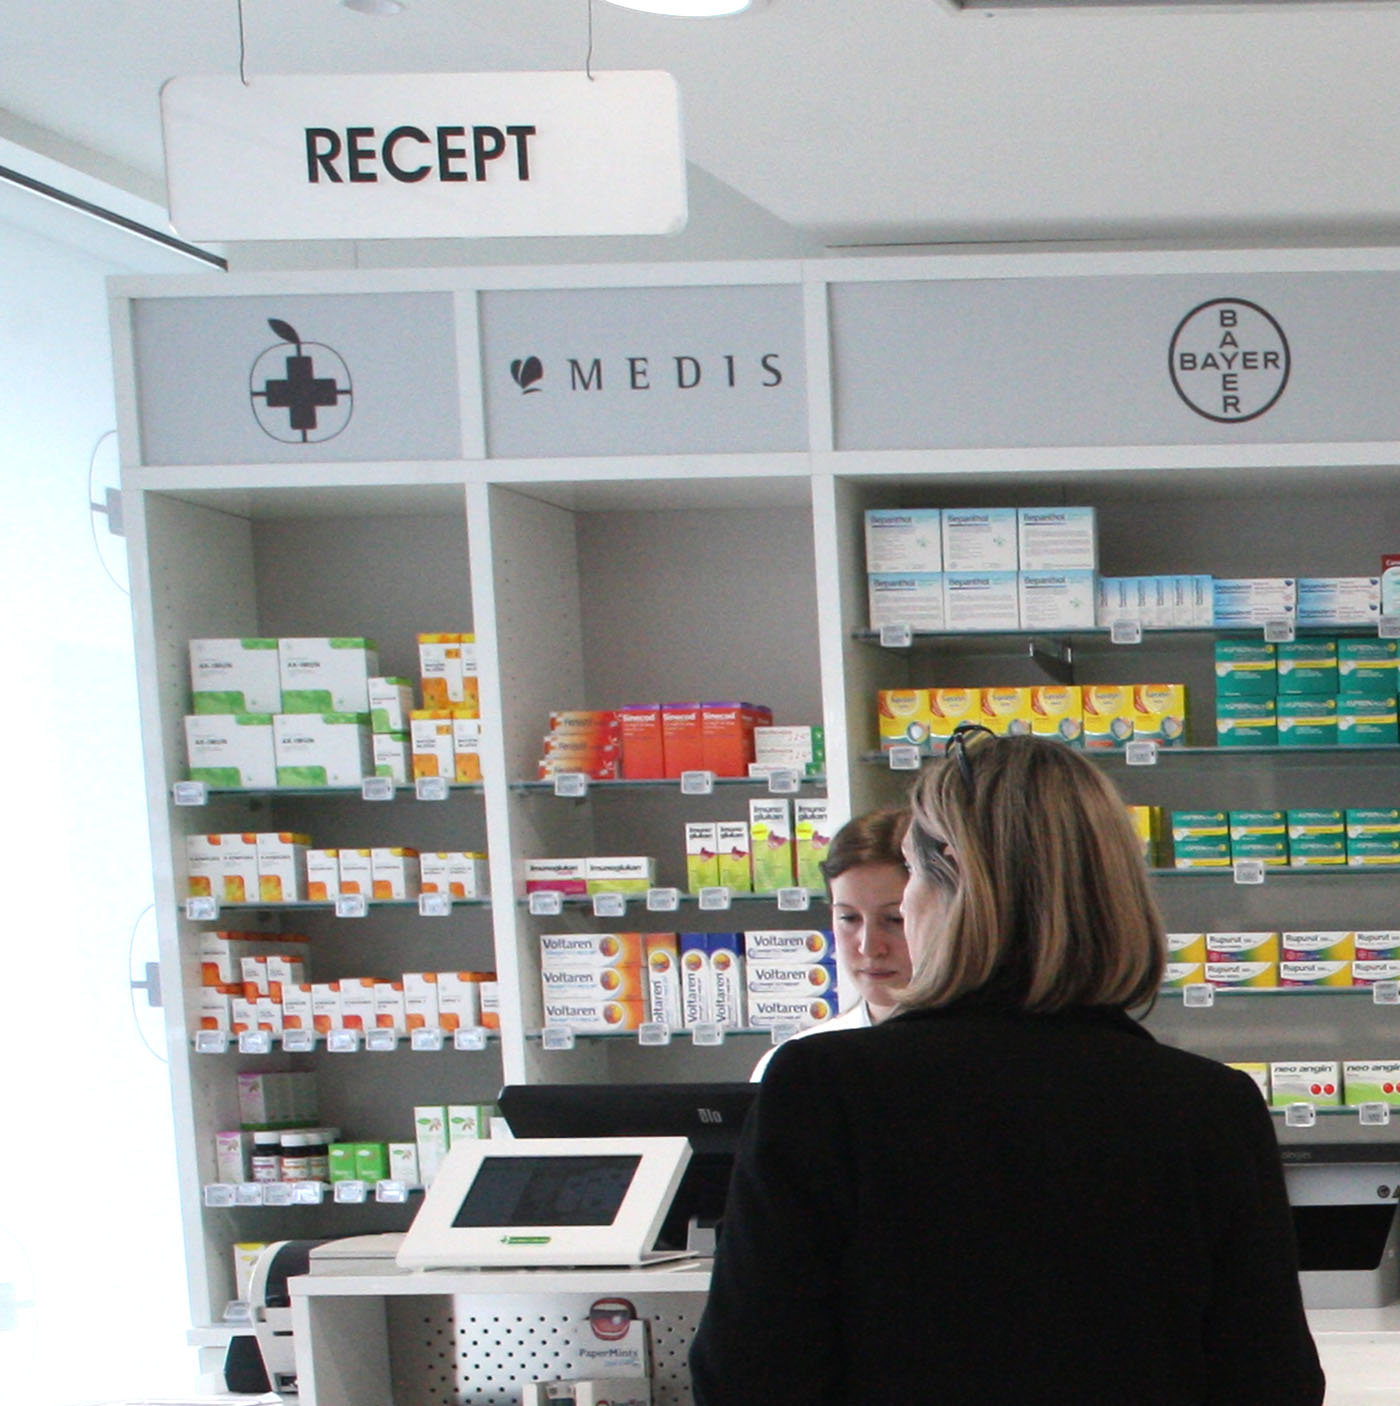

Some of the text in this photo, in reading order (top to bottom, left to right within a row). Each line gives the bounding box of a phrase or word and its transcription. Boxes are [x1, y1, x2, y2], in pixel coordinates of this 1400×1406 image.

[305, 126, 536, 183] RECEPT
[1180, 352, 1280, 371] BAYER
[1219, 310, 1240, 413] BAYER
[569, 354, 782, 391] MEDIS
[623, 713, 656, 722] Sinecod
[664, 712, 696, 722] Sinecod
[703, 712, 736, 721] Sinecod
[543, 938, 592, 949] Voltaren
[754, 935, 804, 947] Voltaren
[544, 972, 593, 983] Voltaren
[756, 969, 806, 980] Voltaren
[654, 980, 662, 1023] oltaren
[688, 973, 696, 1023] Voltaren
[716, 973, 724, 1023] Voltaren
[1299, 1065, 1332, 1074] angin
[579, 1348, 638, 1360] PaperMints
